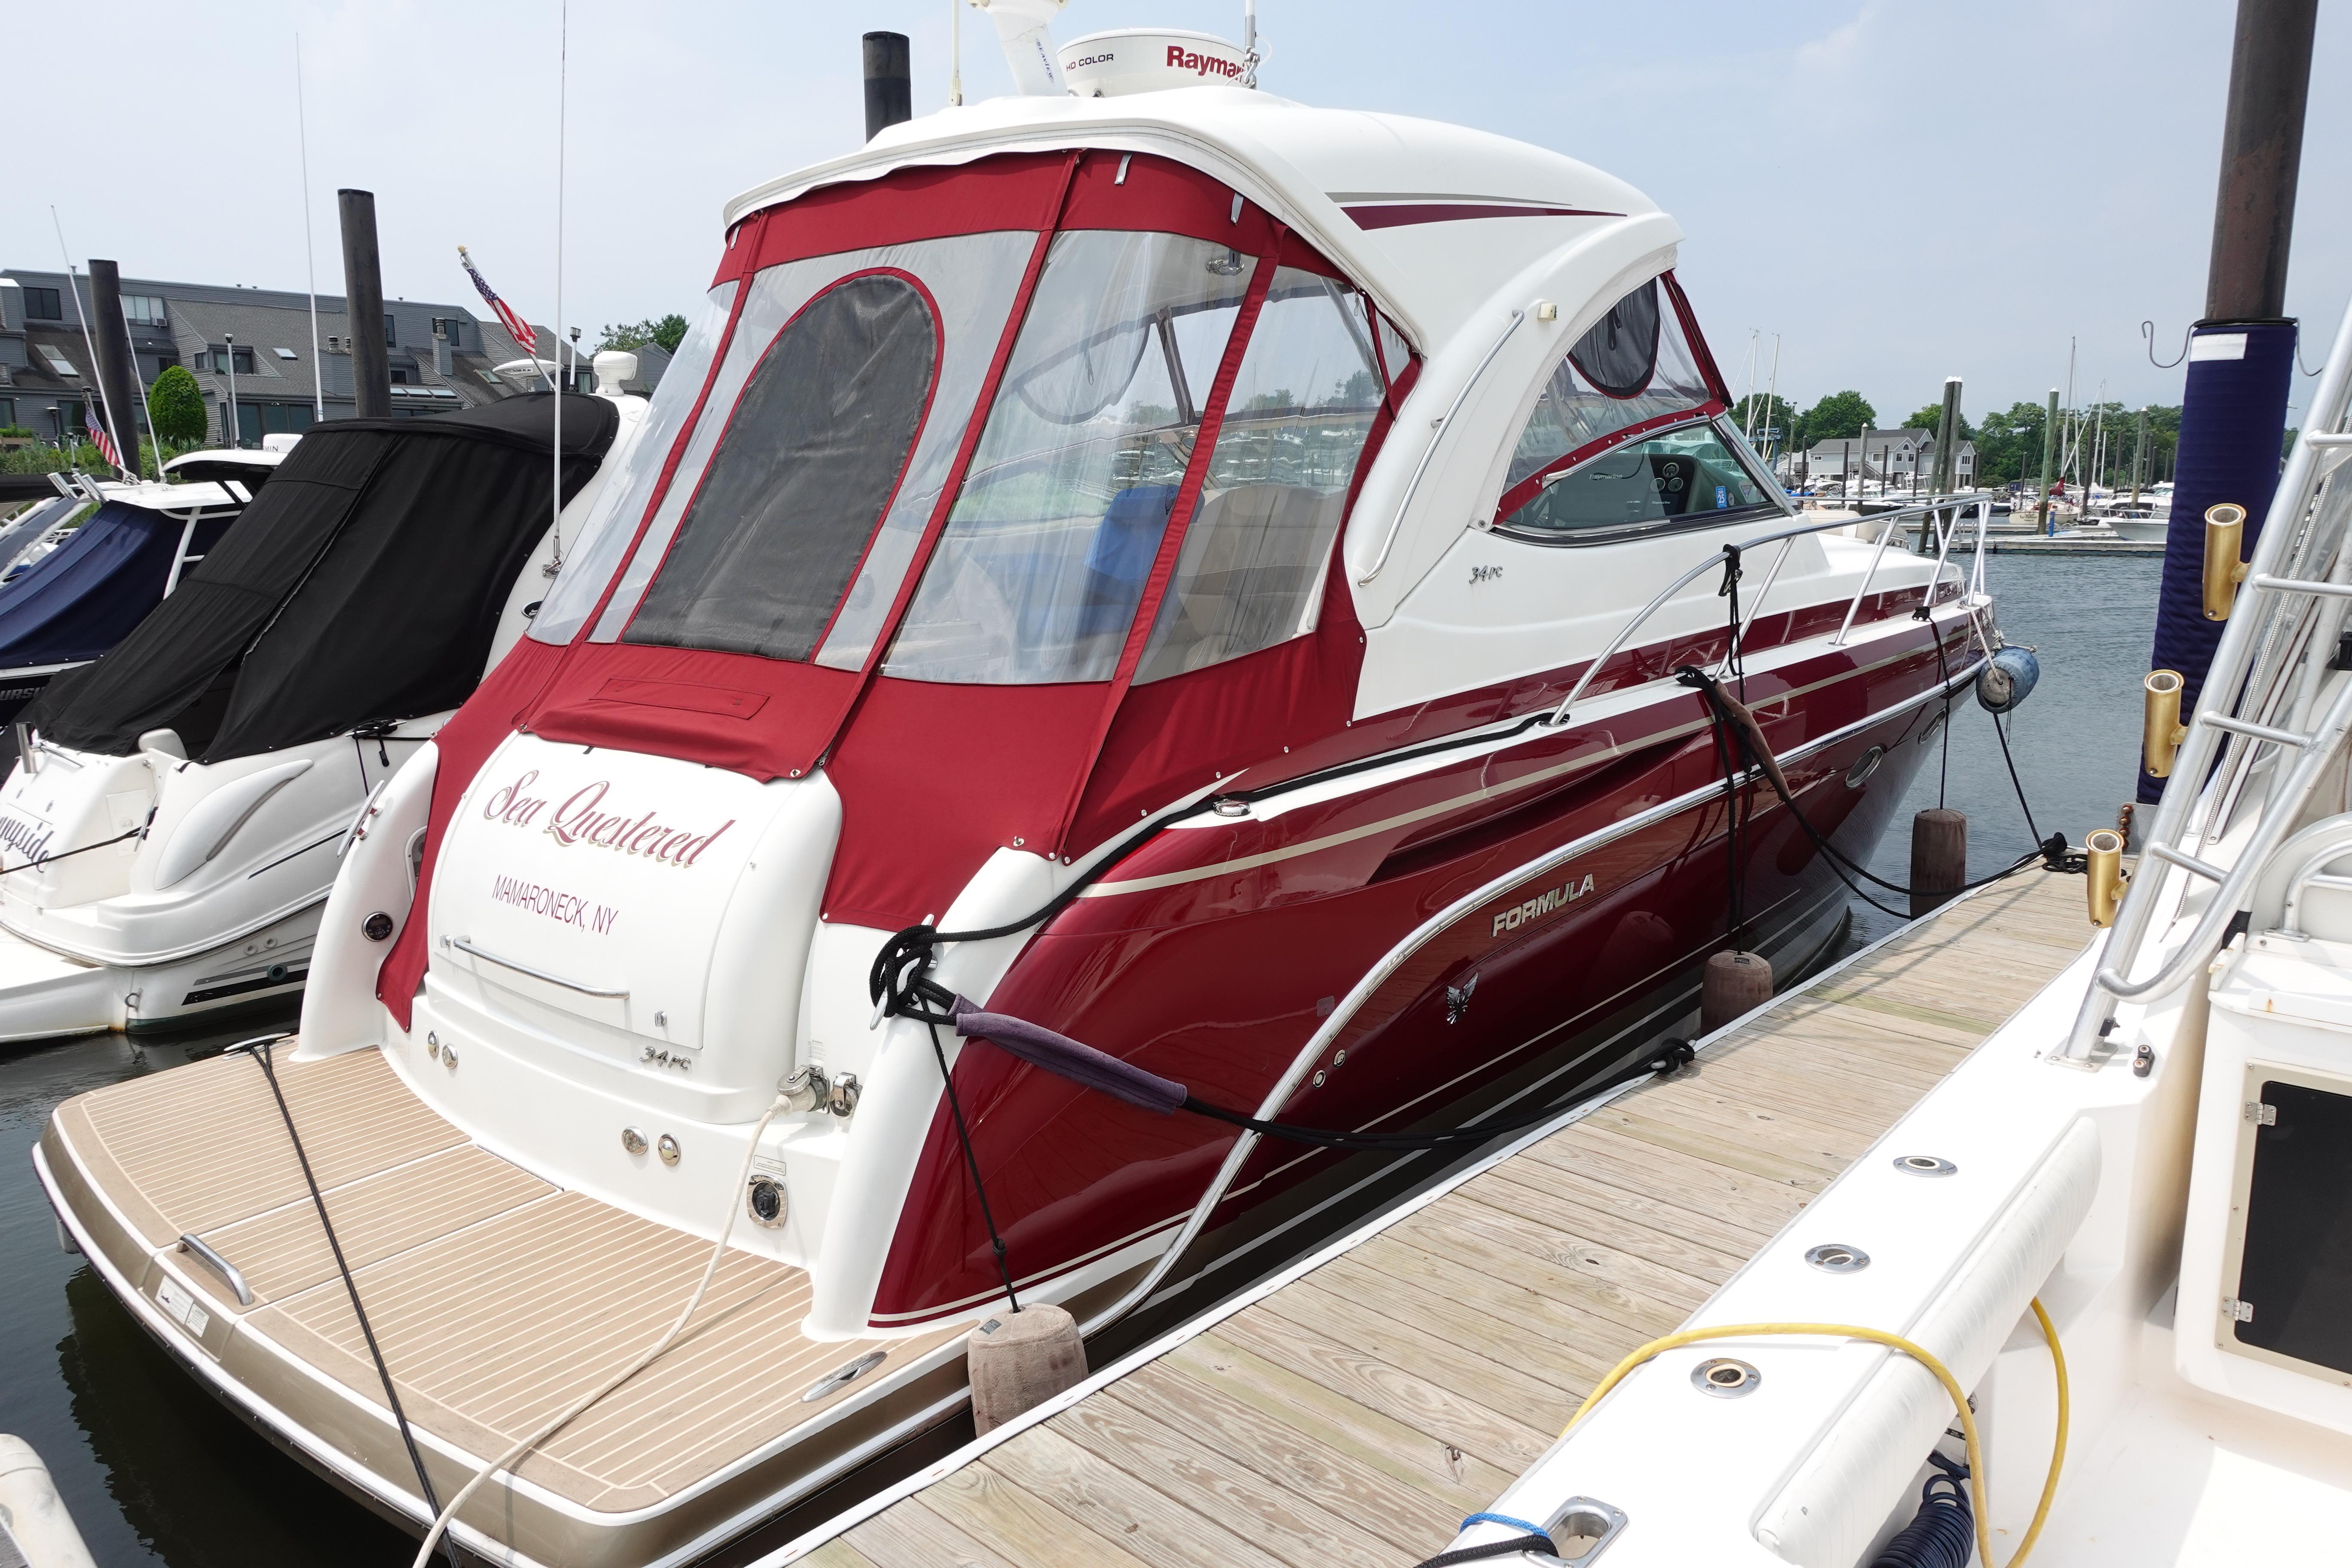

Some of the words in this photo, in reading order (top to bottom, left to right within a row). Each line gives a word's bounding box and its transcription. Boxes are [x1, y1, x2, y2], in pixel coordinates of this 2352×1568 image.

[1066, 61, 1076, 72] HD
[1079, 54, 1114, 66] COLOR
[1167, 46, 1246, 83] Raymari
[1718, 494, 1725, 504] 25
[483, 770, 548, 826] Sea
[542, 781, 736, 869] Questered
[492, 874, 589, 932] MAMARONECK,
[592, 905, 619, 936] NY
[1490, 873, 1595, 938] FORMULA
